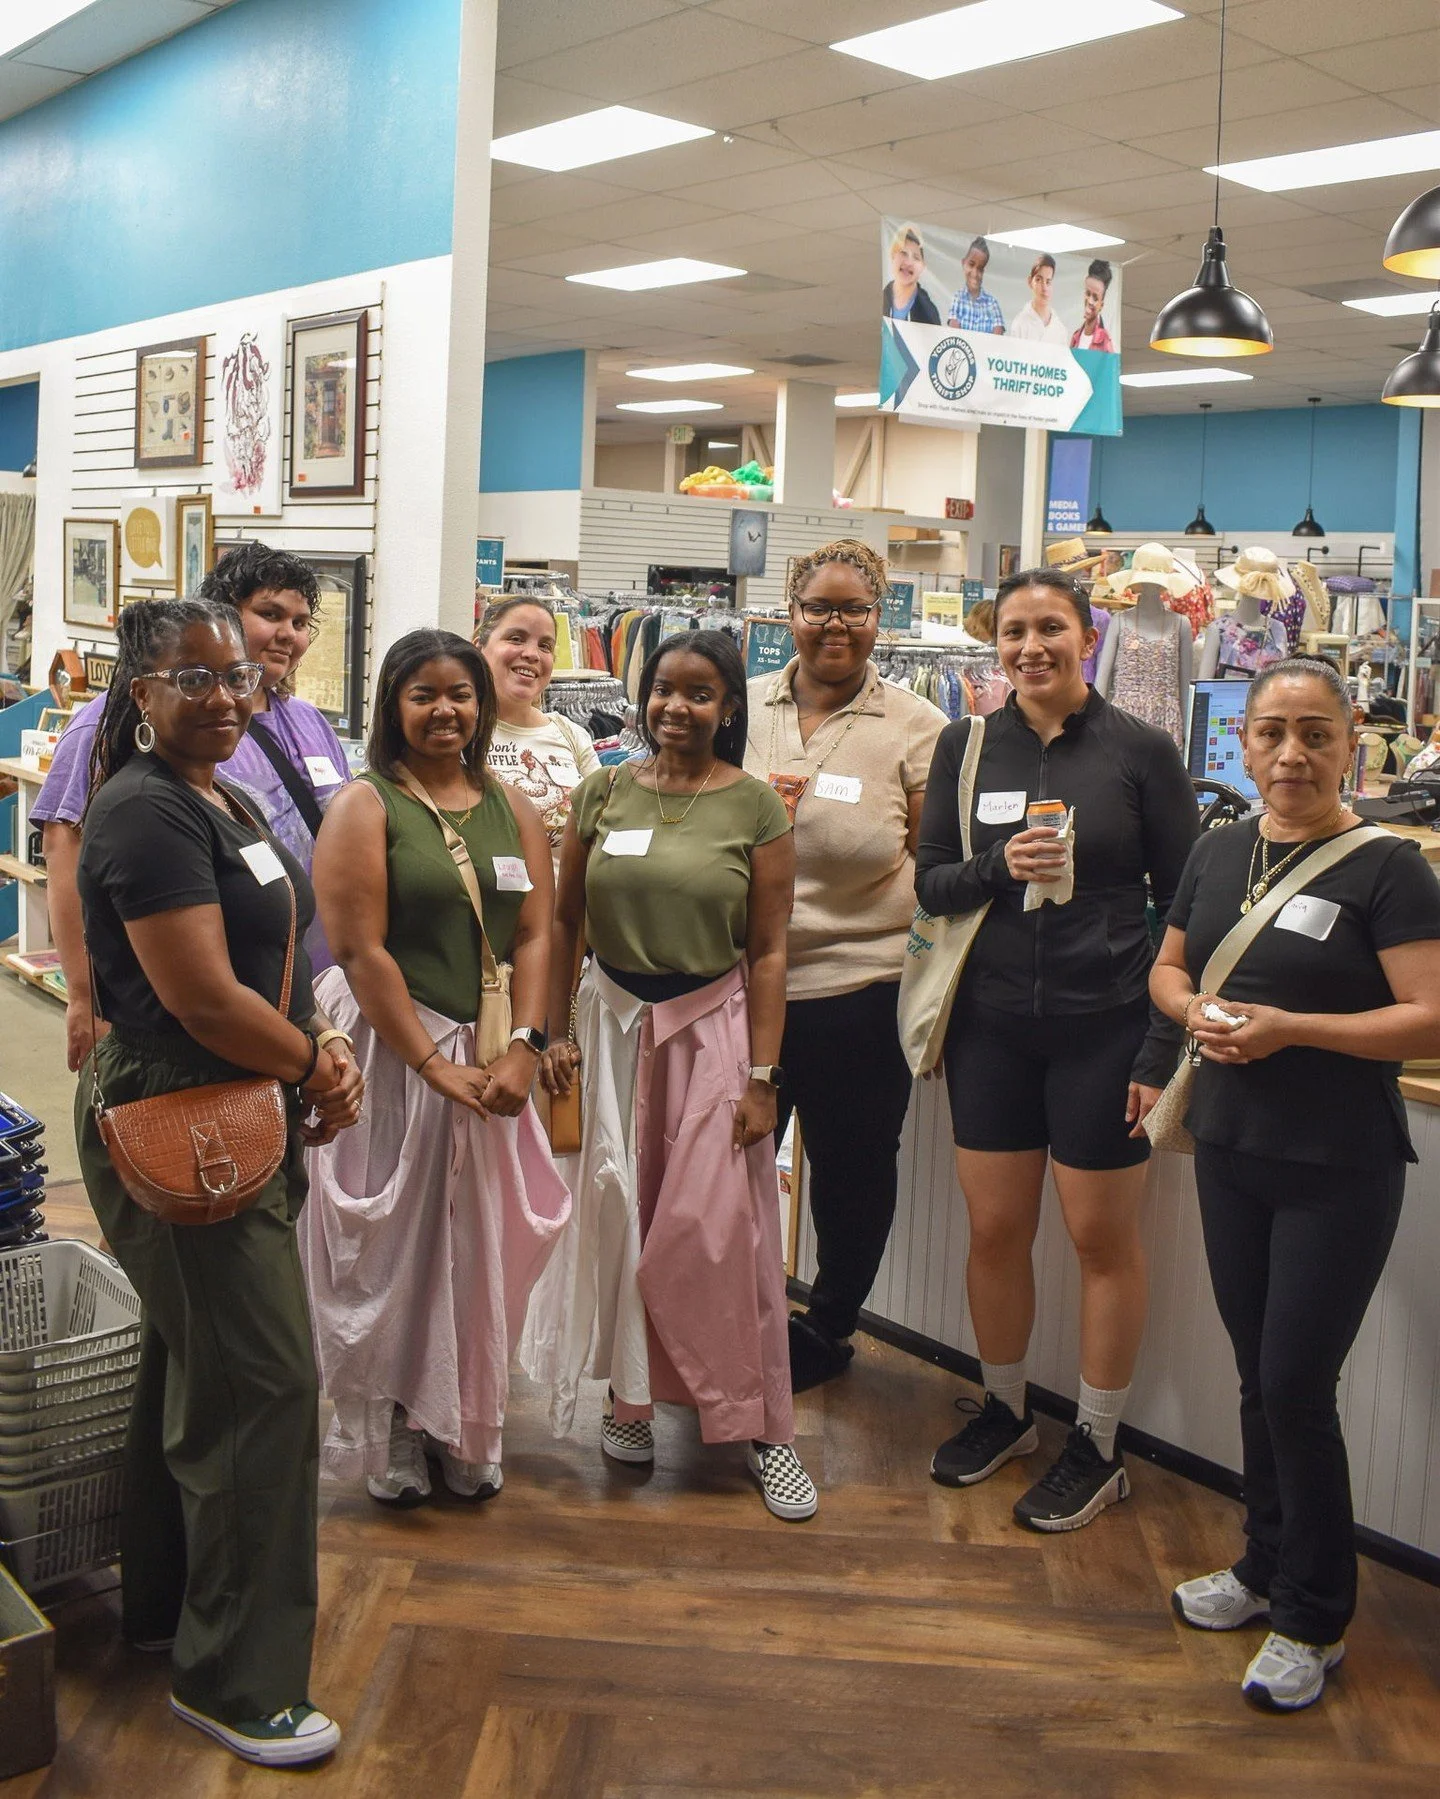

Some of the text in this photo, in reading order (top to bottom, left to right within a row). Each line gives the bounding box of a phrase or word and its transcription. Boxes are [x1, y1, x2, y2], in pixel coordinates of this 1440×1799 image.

[931, 338, 975, 366] YOUTH HOMES
[987, 357, 1067, 382] YOUTH HOMES
[931, 372, 975, 399] THRIFT SHOP
[993, 376, 1064, 398] THRIFT SHOP
[950, 500, 967, 518] EXIT
[1049, 500, 1079, 510] MEDIA
[1048, 511, 1081, 521] BOOKS
[1047, 522, 1054, 531] &
[759, 646, 781, 656] TOPS
[90, 660, 113, 684] LOV
[487, 754, 519, 766] UFFLE
